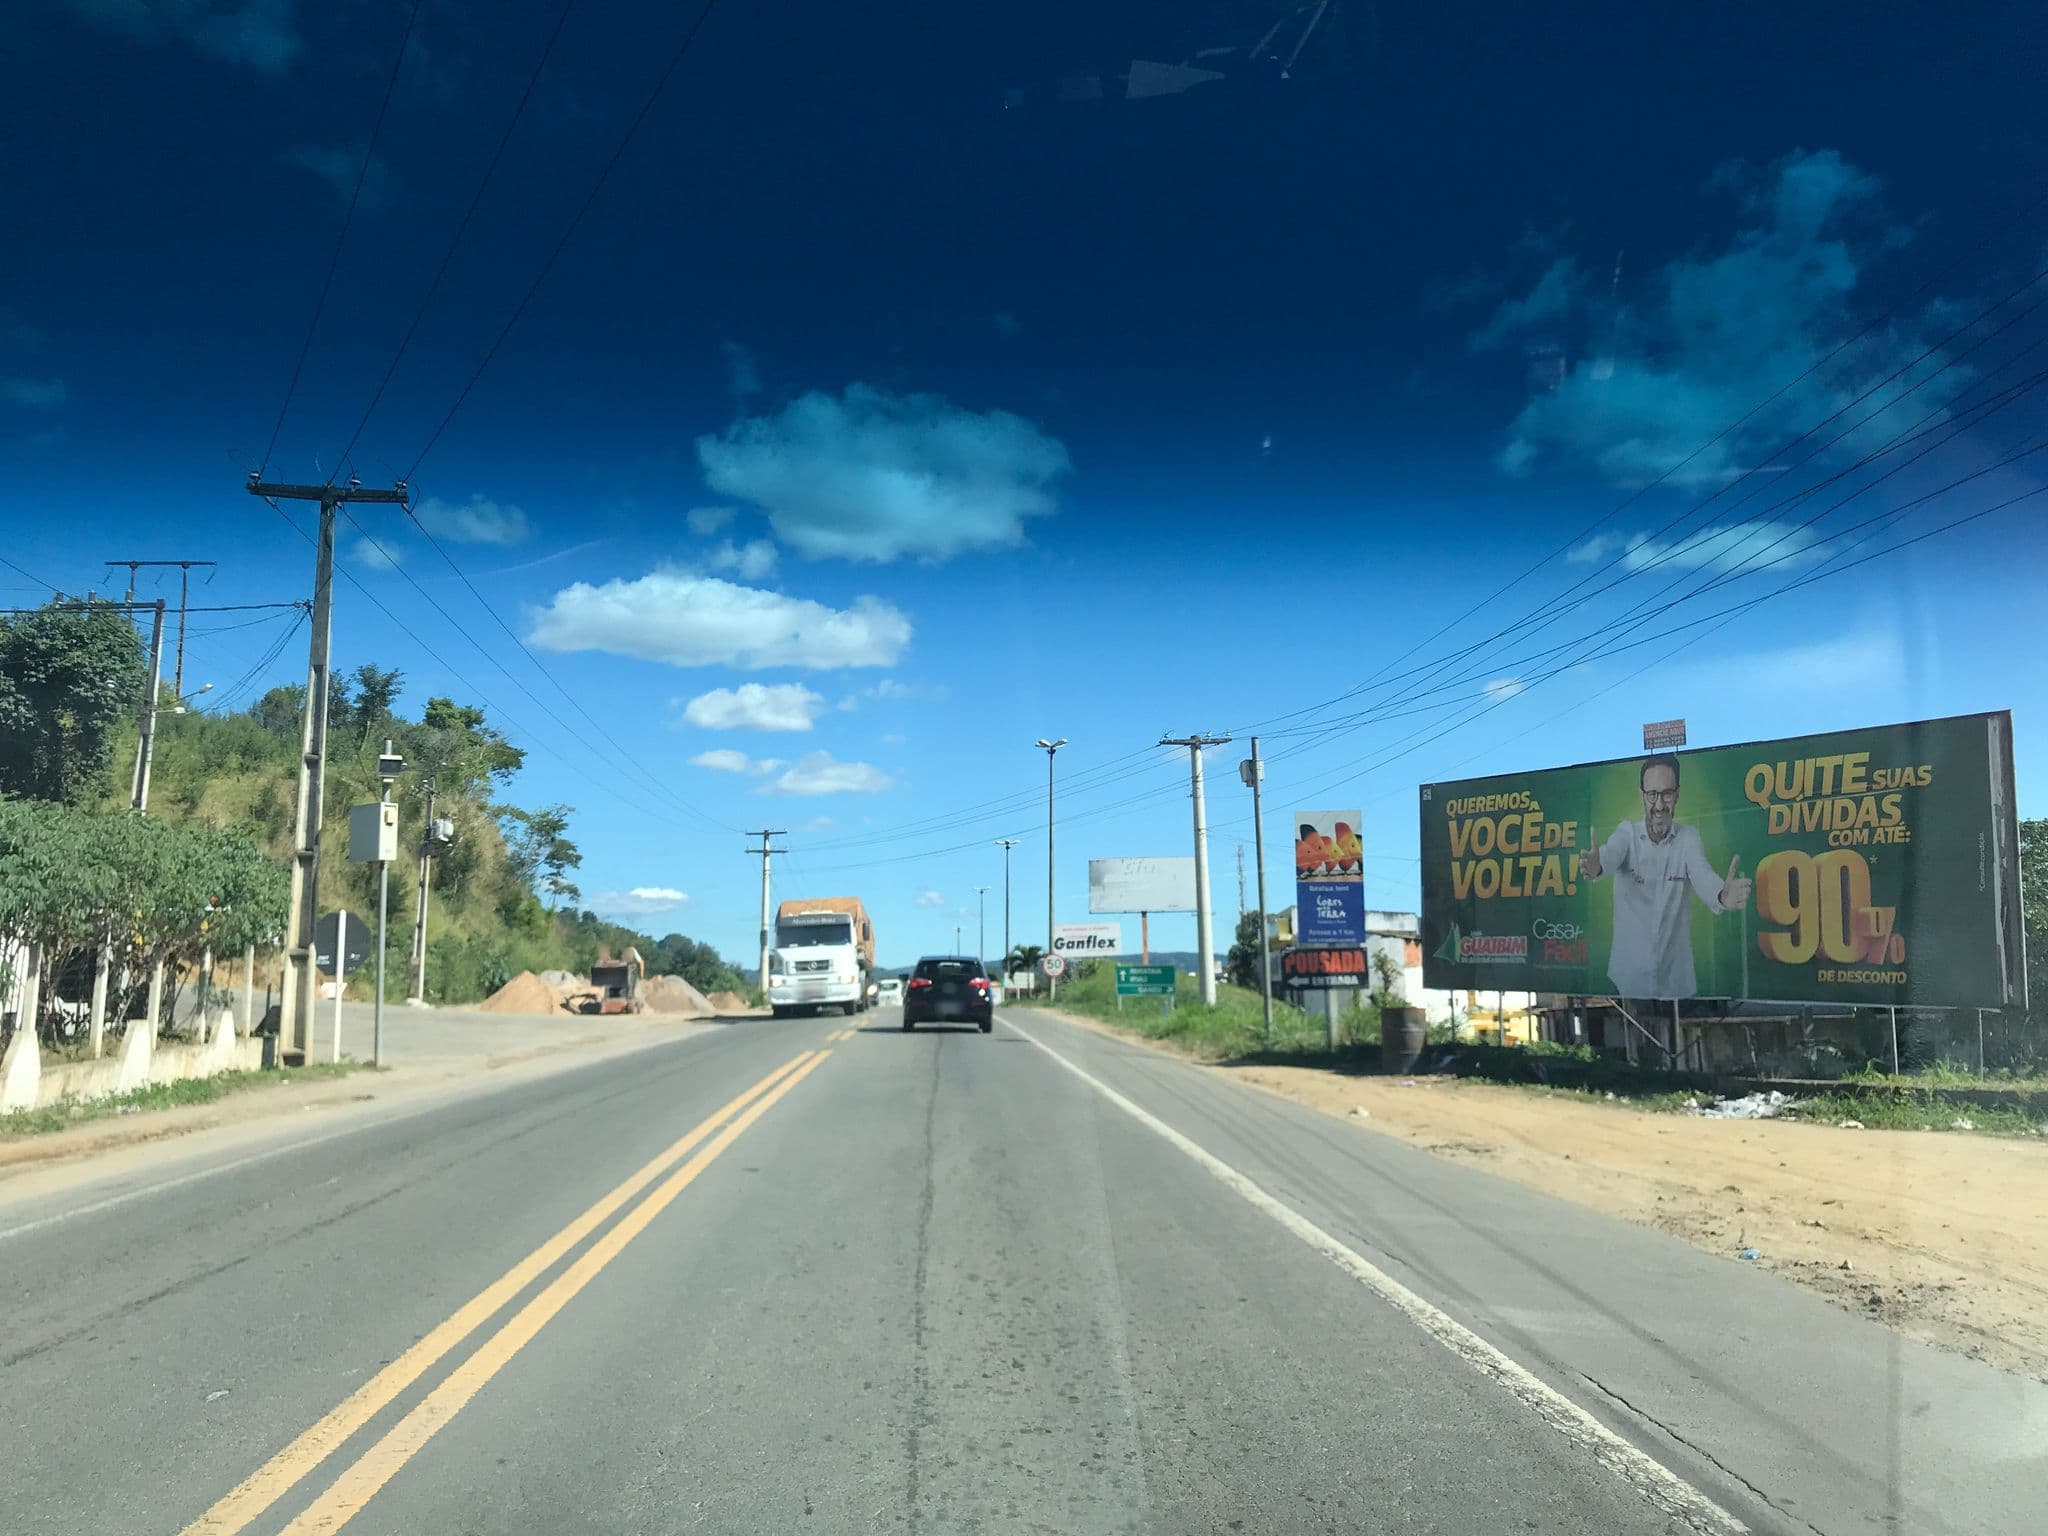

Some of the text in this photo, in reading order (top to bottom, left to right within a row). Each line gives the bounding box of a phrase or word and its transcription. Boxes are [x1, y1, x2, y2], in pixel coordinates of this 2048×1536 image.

[1744, 752, 1932, 810] QUITE SUAS
[1446, 790, 1531, 818] QUEREMOS
[1767, 793, 1903, 835] DÍVIDAS
[1448, 800, 1578, 858] VOCÊ DE
[1828, 821, 1911, 846] COM ATÉ:
[1451, 853, 1580, 900] VOLTA!
[1054, 935, 1116, 950] Ganflex
[1047, 959, 1062, 970] 50
[1284, 951, 1366, 974] POUSADA
[1311, 975, 1359, 985] ENTRADA
[1818, 969, 1908, 984] DE DESCONTO
